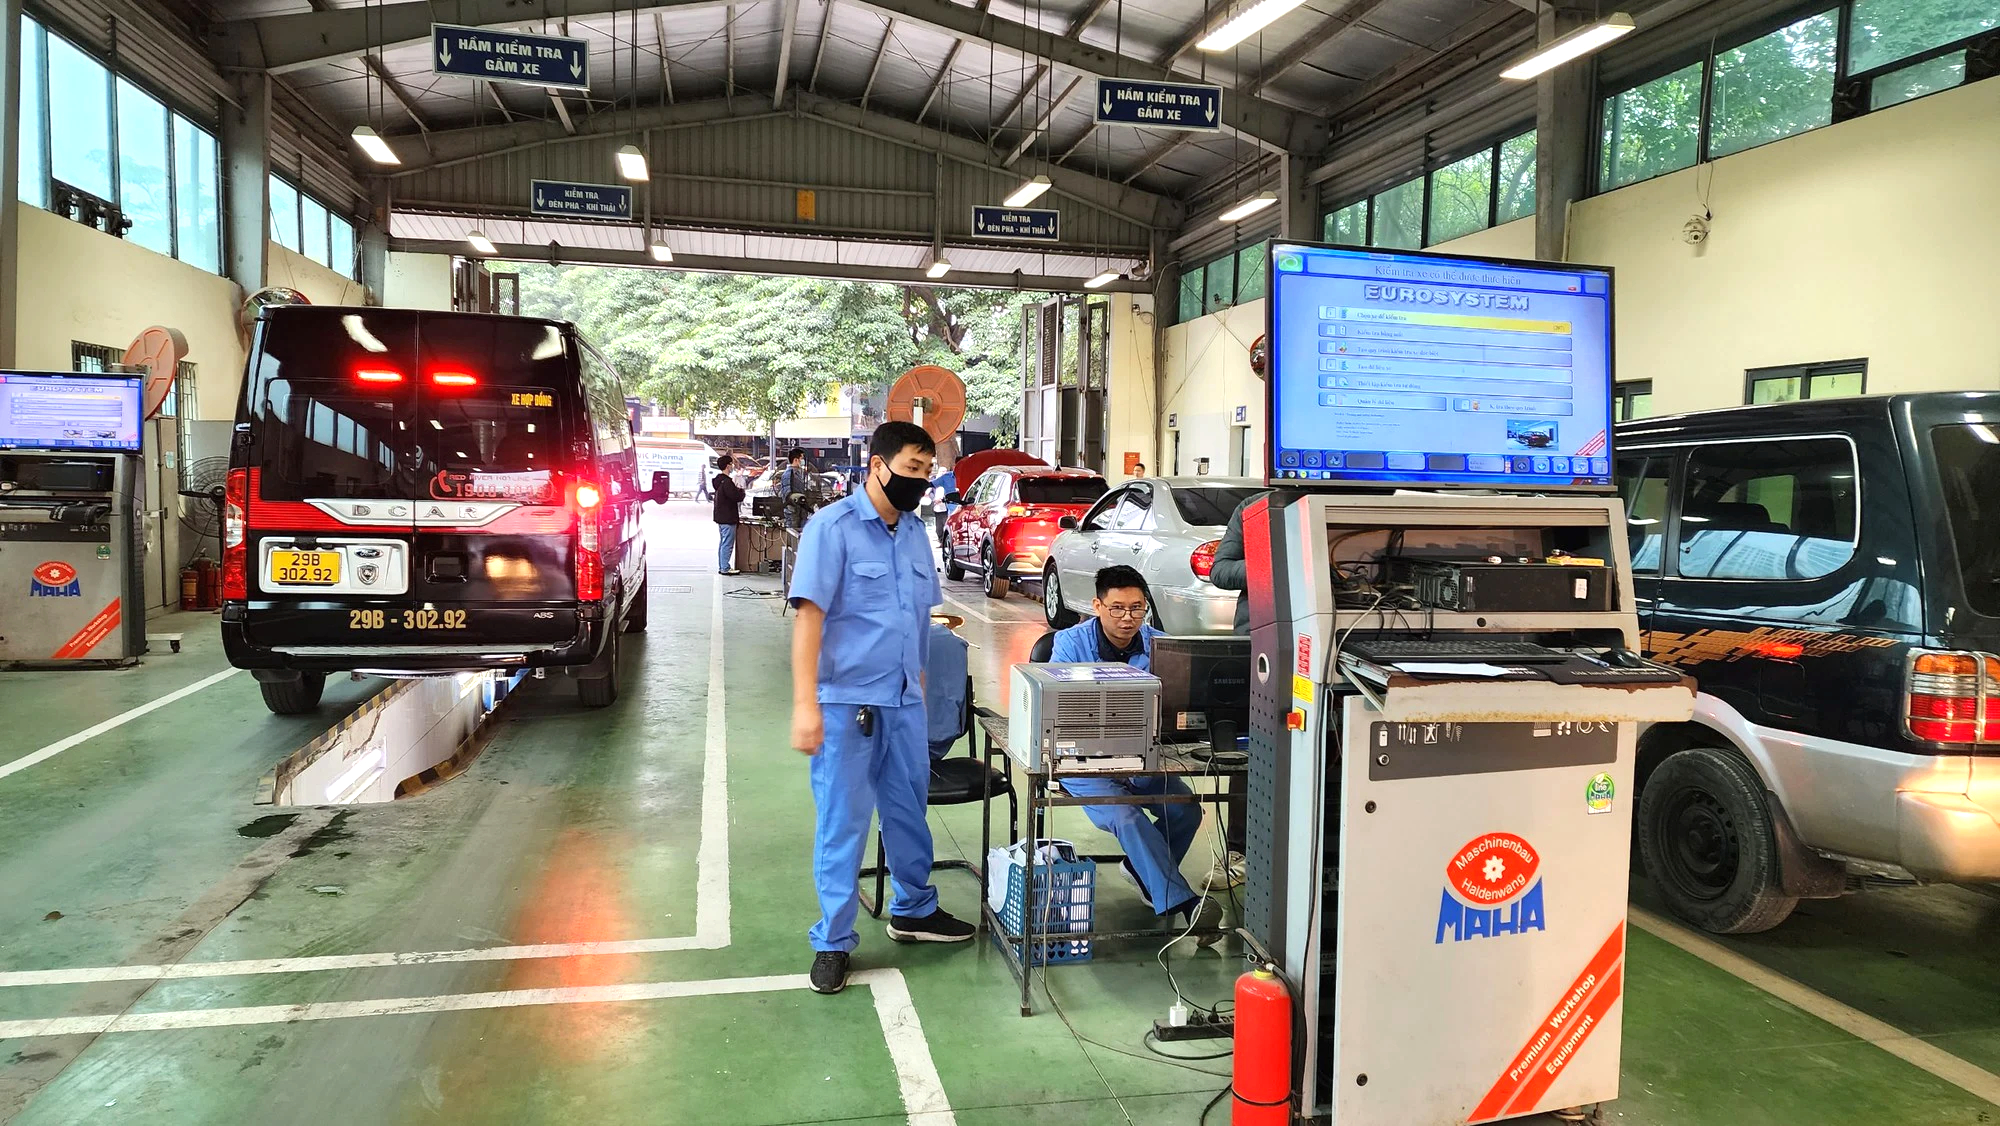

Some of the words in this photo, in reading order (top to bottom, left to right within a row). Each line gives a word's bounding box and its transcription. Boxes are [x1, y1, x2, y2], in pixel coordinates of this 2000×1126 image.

[458, 35, 491, 52] HẦM
[496, 39, 532, 56] KIỂM
[536, 46, 563, 60] TRA
[485, 56, 517, 73] GẦM
[521, 63, 540, 75] XE
[1117, 87, 1143, 101] HẦM
[1147, 88, 1176, 104] KIỂM
[1179, 95, 1201, 106] TRA
[1137, 104, 1163, 119] GẦM
[1167, 109, 1181, 120] XE
[564, 187, 583, 198] KIỂM
[585, 191, 599, 200] TRA
[565, 202, 580, 210] PHA
[586, 201, 599, 211] KHÍ
[600, 202, 616, 212] THẢI
[1001, 211, 1018, 223] KIỂM
[1018, 215, 1031, 223] TRA
[1001, 225, 1014, 233] PHA
[1019, 224, 1031, 234] KHÍ
[1375, 264, 1400, 277] Kiểm
[1402, 269, 1414, 278] tra
[1417, 271, 1429, 279] xe
[1429, 270, 1441, 280] có
[1443, 269, 1457, 281] thể
[1363, 284, 1529, 311] EUROSYSTEM
[511, 393, 520, 406] XE
[520, 393, 534, 408] HỢP
[652, 453, 684, 461] Pharma
[455, 483, 497, 498] 1900
[351, 504, 478, 519] DCAR
[291, 553, 320, 566] 29B
[279, 567, 332, 581] 302.92
[30, 577, 81, 597] MAHA
[349, 609, 385, 630] 29B
[403, 609, 467, 630] 302.92
[532, 612, 554, 620] ABS
[1455, 836, 1534, 870] Maschinenbau
[1461, 873, 1526, 901] Haldenwang
[1435, 875, 1545, 944] MAHA
[1509, 1031, 1551, 1082] Premium
[1549, 973, 1596, 1029] Workshop
[1545, 1014, 1594, 1075] Equipment
